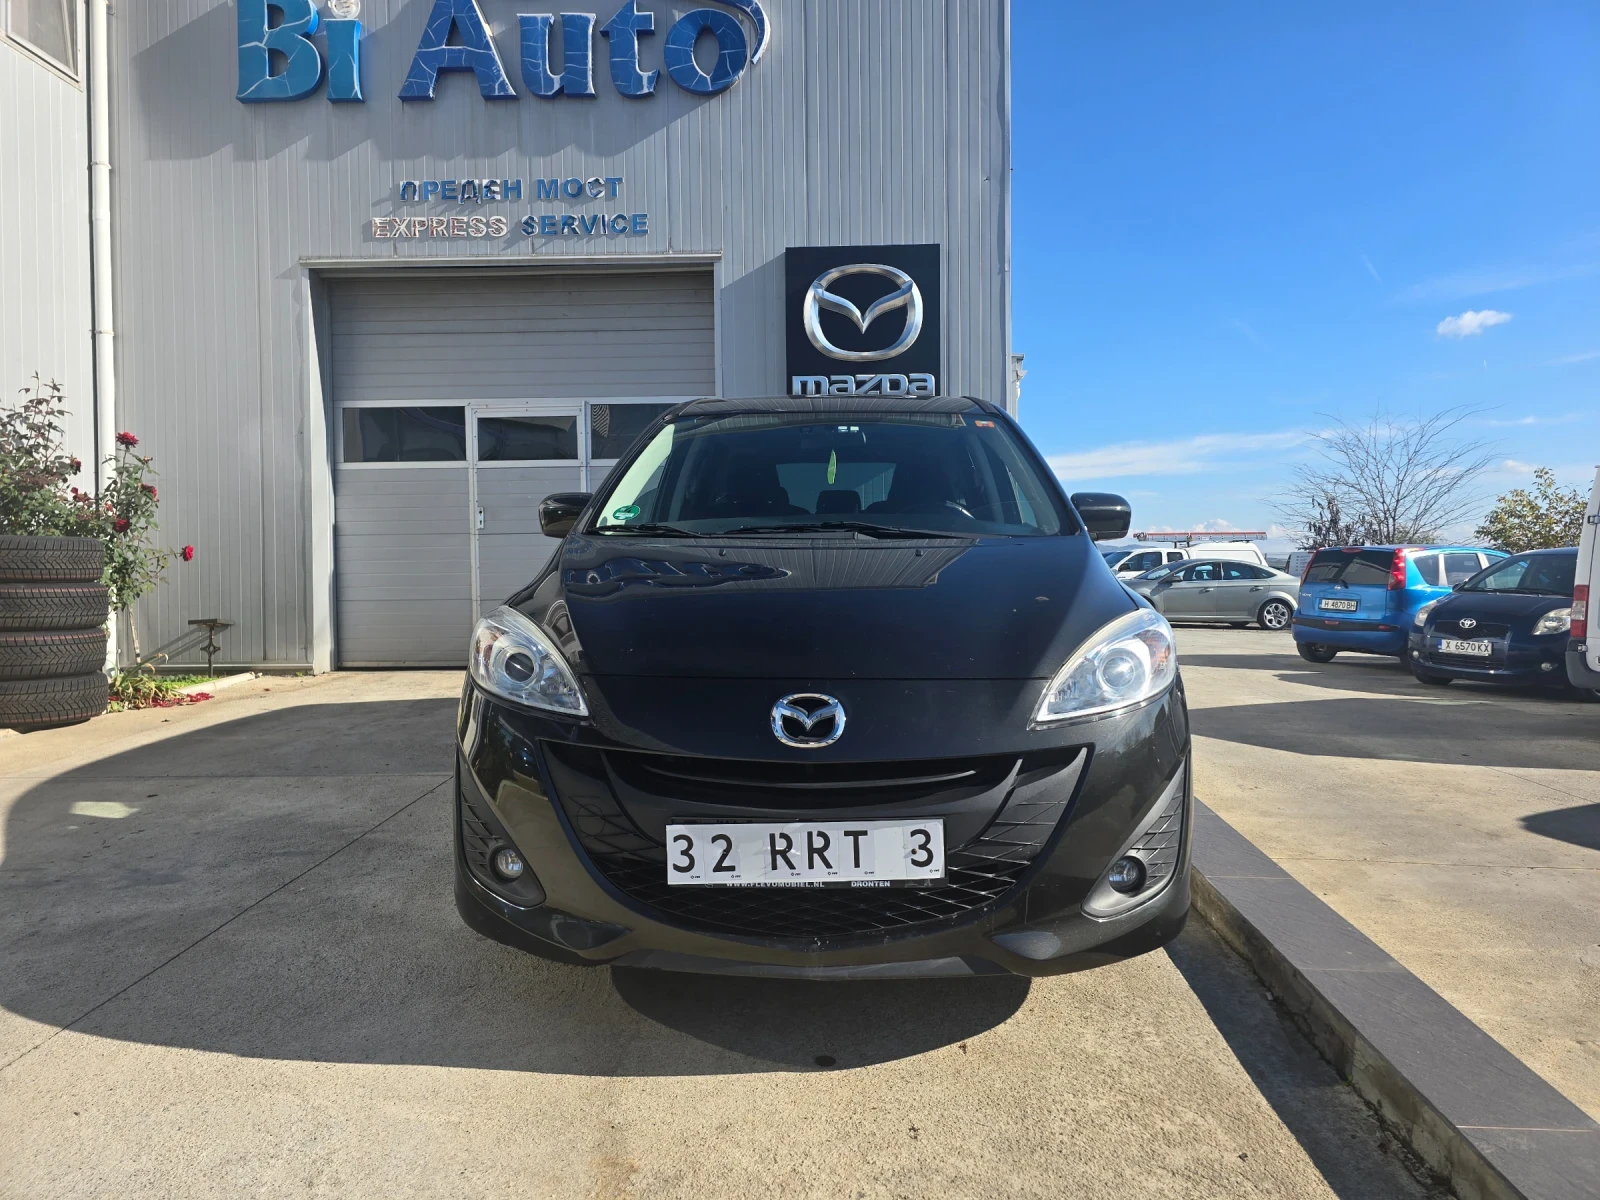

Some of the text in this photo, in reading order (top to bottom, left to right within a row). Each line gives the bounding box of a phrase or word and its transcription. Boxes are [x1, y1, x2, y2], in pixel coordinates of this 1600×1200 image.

[235, 0, 752, 102] Bi Auto
[399, 176, 624, 204] ПРЕДЕН МОСТ
[372, 213, 650, 238] EXPRESS SERVICE
[1455, 641, 1477, 651] 6570
[672, 828, 934, 874] 32 RRT 3
